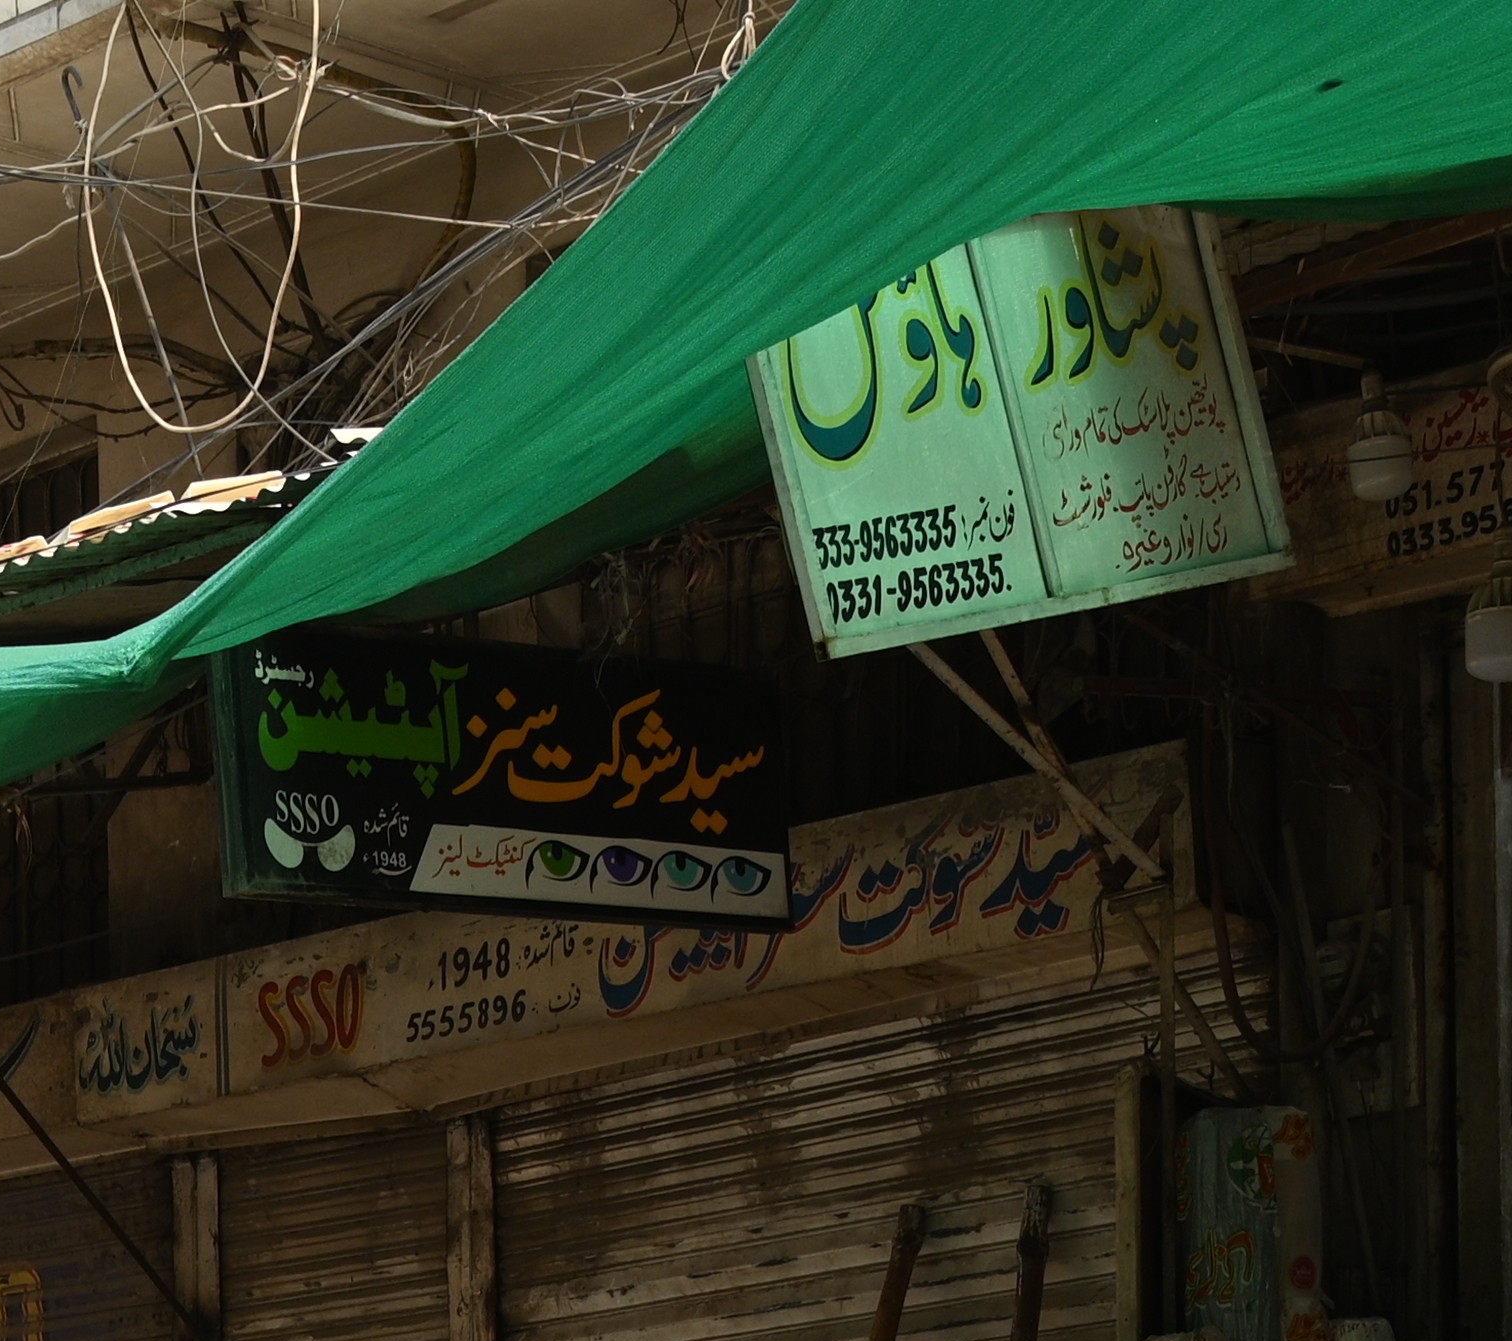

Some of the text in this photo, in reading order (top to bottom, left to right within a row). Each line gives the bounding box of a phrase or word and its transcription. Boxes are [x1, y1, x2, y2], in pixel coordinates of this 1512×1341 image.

[1030, 214, 1200, 387] پشاور
[254, 649, 316, 689] رجسٹرڈ
[257, 659, 765, 834] سید شوکت سنز آپٹیشن
[276, 789, 340, 836] SSSO
[256, 960, 368, 1069] SSSO
[406, 989, 526, 1043] 5555896
